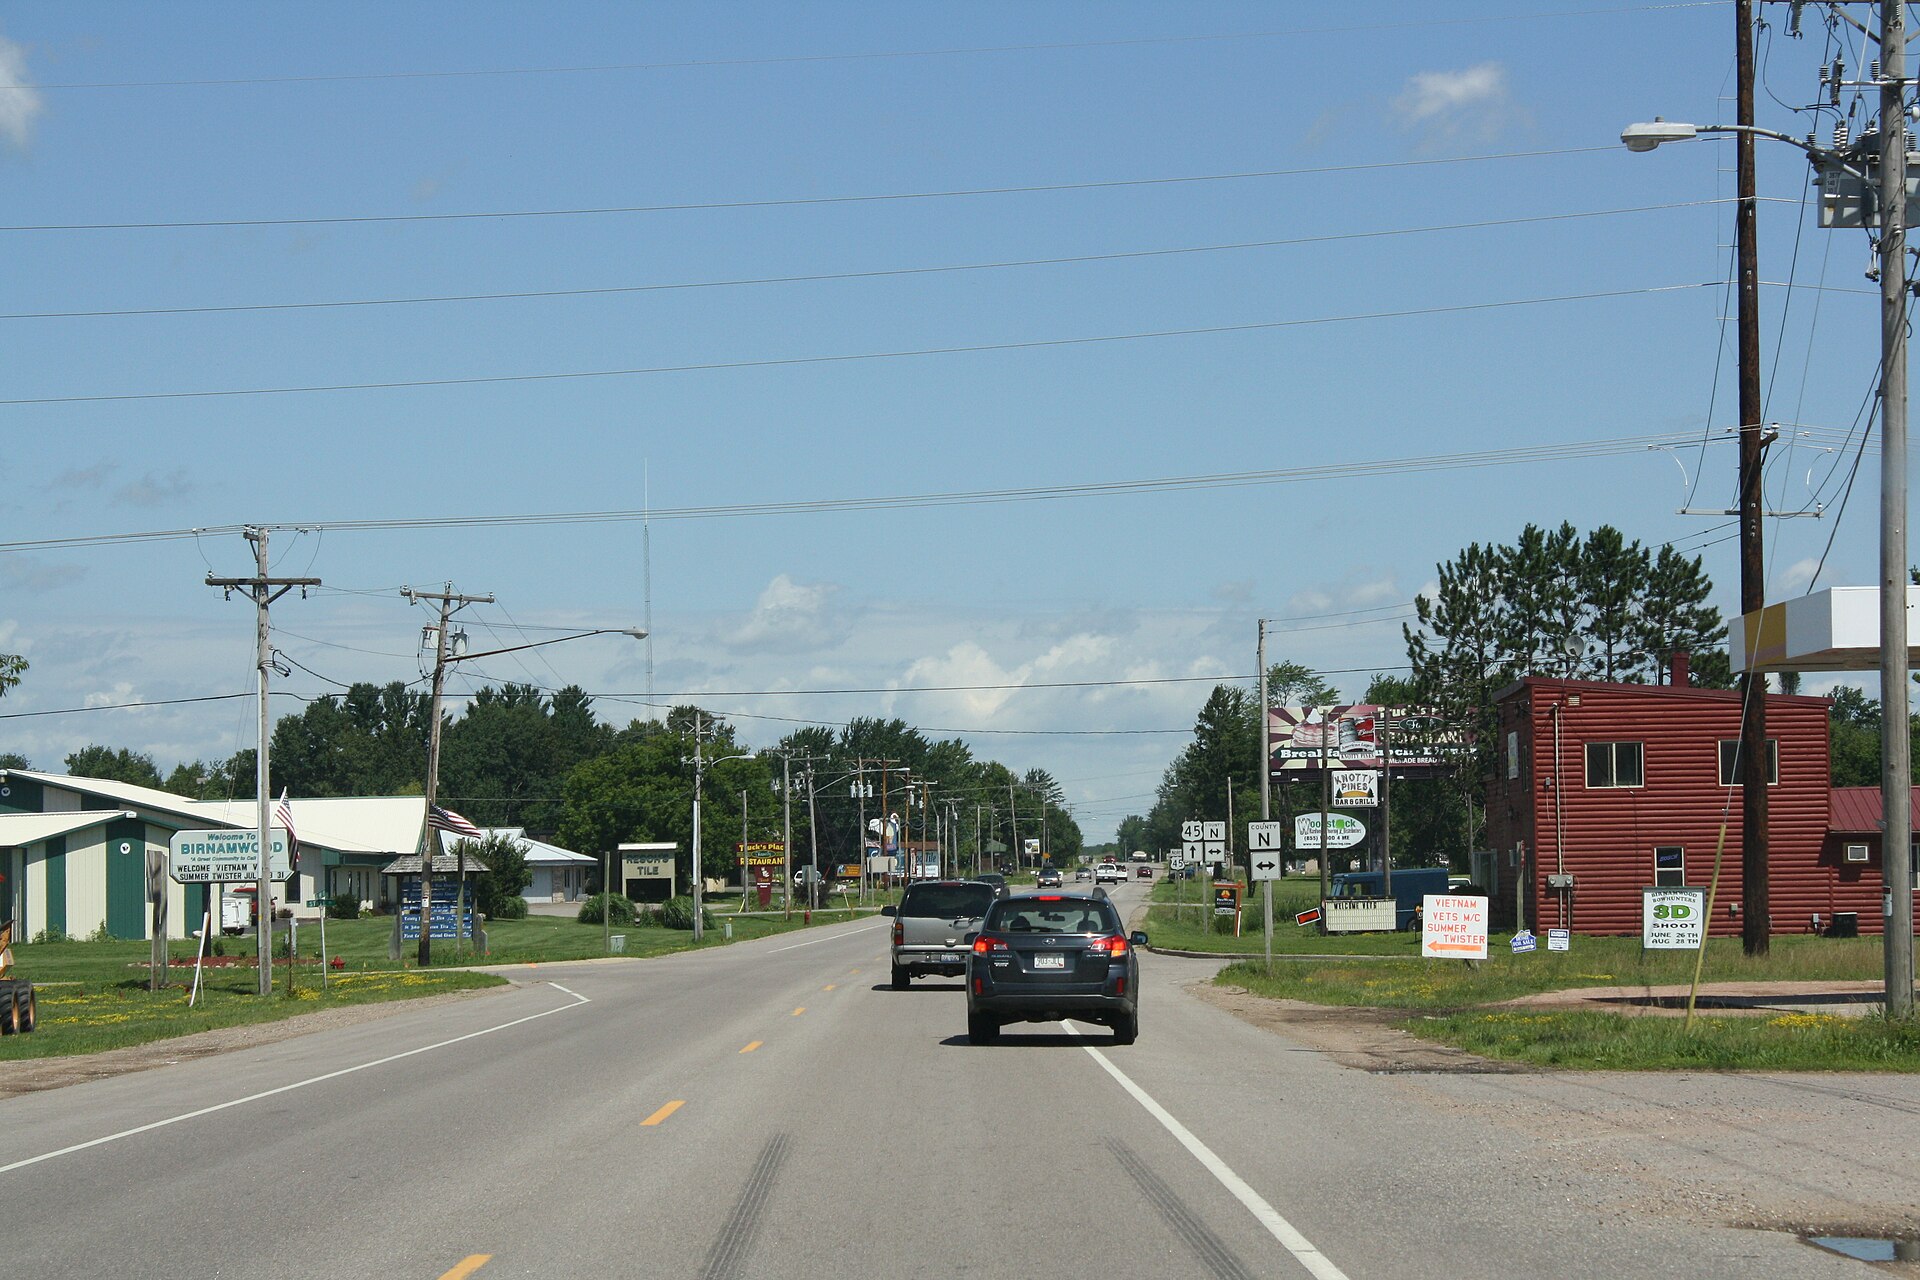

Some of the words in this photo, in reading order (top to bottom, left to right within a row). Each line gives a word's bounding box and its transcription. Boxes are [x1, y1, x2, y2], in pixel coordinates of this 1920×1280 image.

[1281, 748, 1339, 758] Breakfa
[1334, 773, 1374, 785] KNOTTY
[1184, 825, 1201, 837] 45
[1210, 828, 1219, 838] N
[1258, 832, 1270, 847] N
[181, 842, 283, 855] BIRNAMWOD
[740, 857, 784, 865] RSTAURANT
[177, 864, 211, 872] WELCOME
[637, 866, 659, 875] TILE
[213, 872, 243, 880] TWISTER
[277, 871, 284, 879] 31
[1651, 890, 1697, 898] BIRNAMWOOD
[1435, 899, 1477, 908] VIETNAM
[1653, 904, 1691, 919] 3D
[1433, 912, 1458, 921] VETS
[1464, 913, 1481, 922] M/C
[1427, 923, 1467, 933] SUMMER
[1443, 934, 1486, 944] TWISTER
